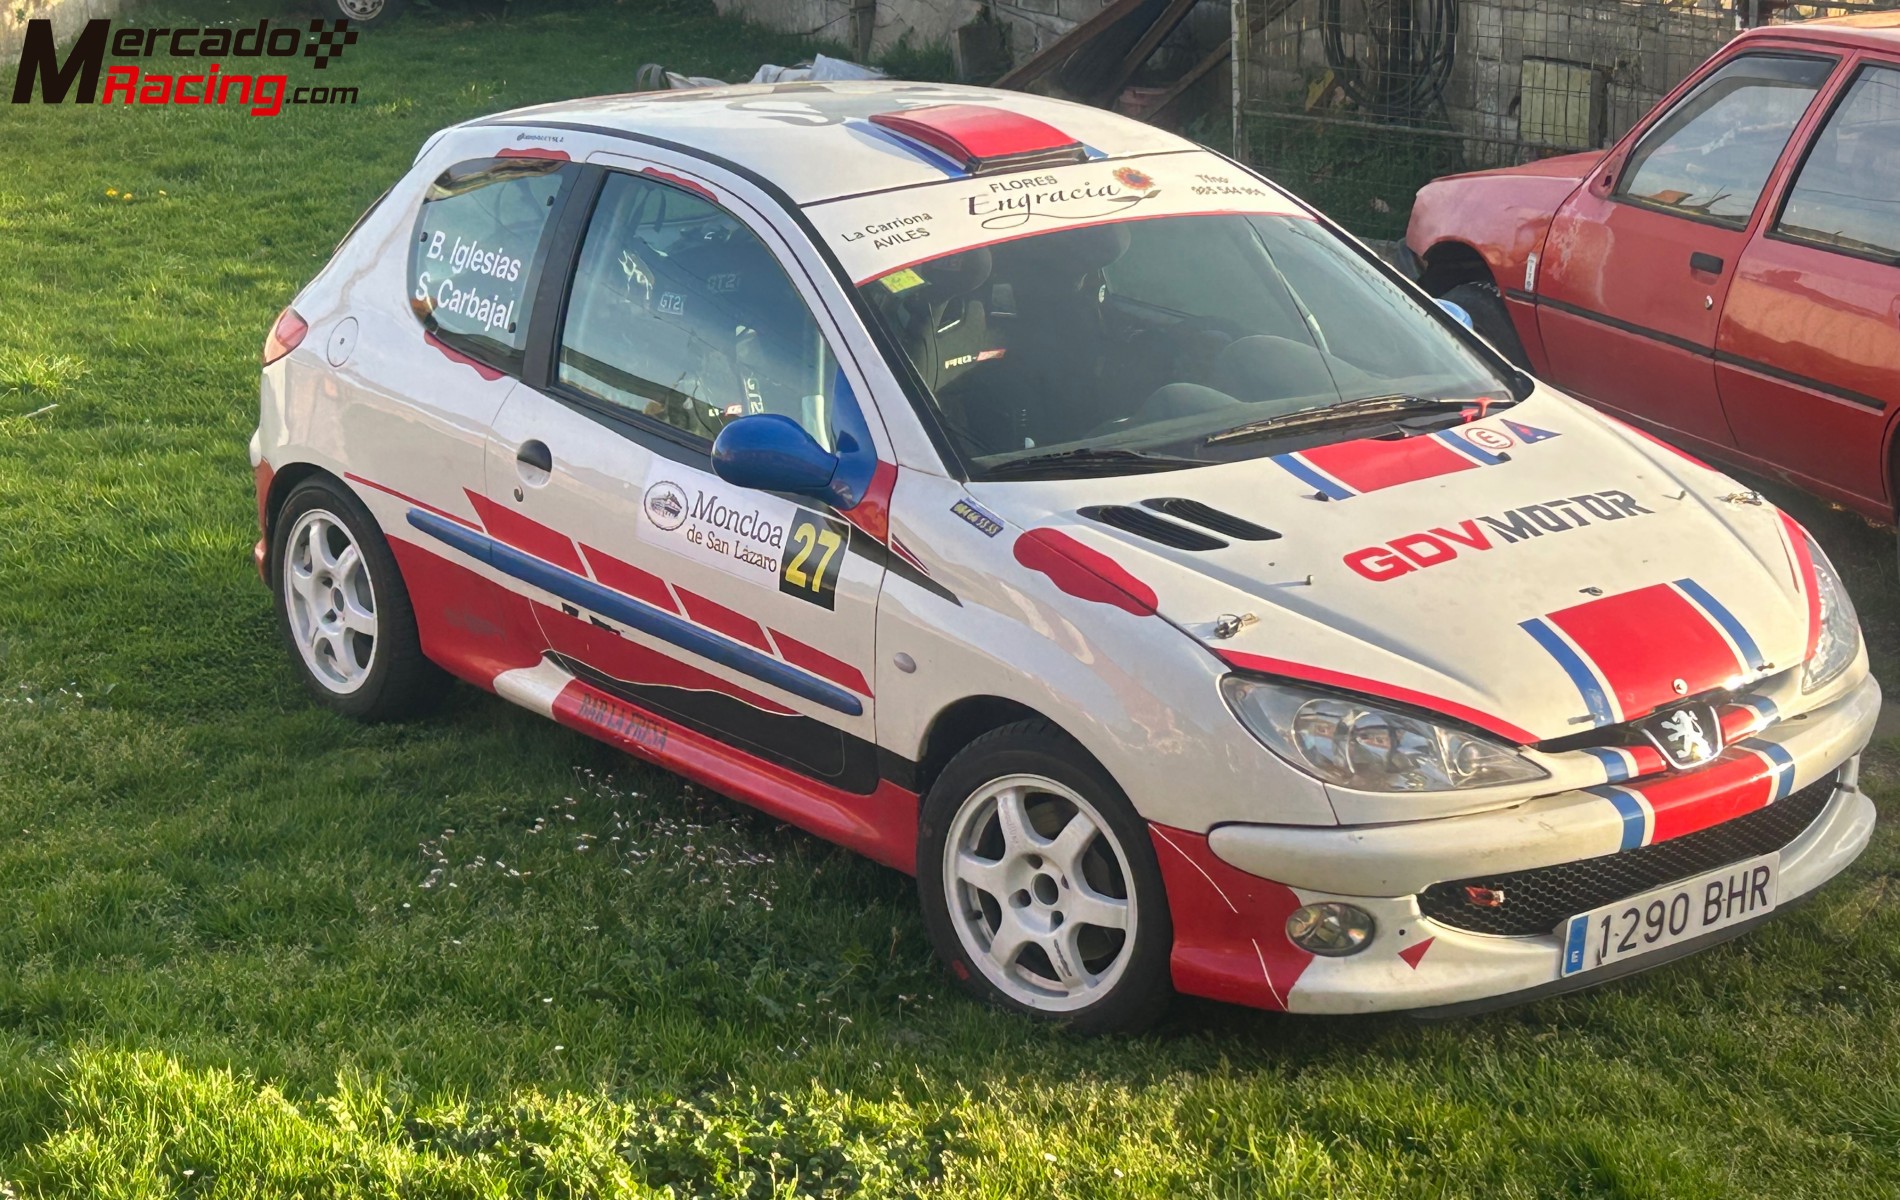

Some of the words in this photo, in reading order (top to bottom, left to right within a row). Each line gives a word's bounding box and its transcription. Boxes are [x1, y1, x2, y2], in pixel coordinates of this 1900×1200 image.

[966, 181, 1121, 229] Engracia
[989, 175, 1058, 193] FLORES
[841, 231, 865, 242] La
[865, 213, 933, 234] Carriona
[874, 227, 930, 250] AVILES
[427, 230, 445, 262] B.
[449, 236, 521, 282] Iglesias
[437, 278, 514, 332] Carbajal
[690, 490, 783, 549] Moncloa
[686, 523, 703, 545] de
[706, 531, 729, 555] San
[734, 540, 778, 573] Lázaro
[785, 522, 842, 593] 27
[1600, 892, 1690, 958] 1290
[1702, 865, 1771, 927] BHR
[1571, 949, 1579, 964] E
